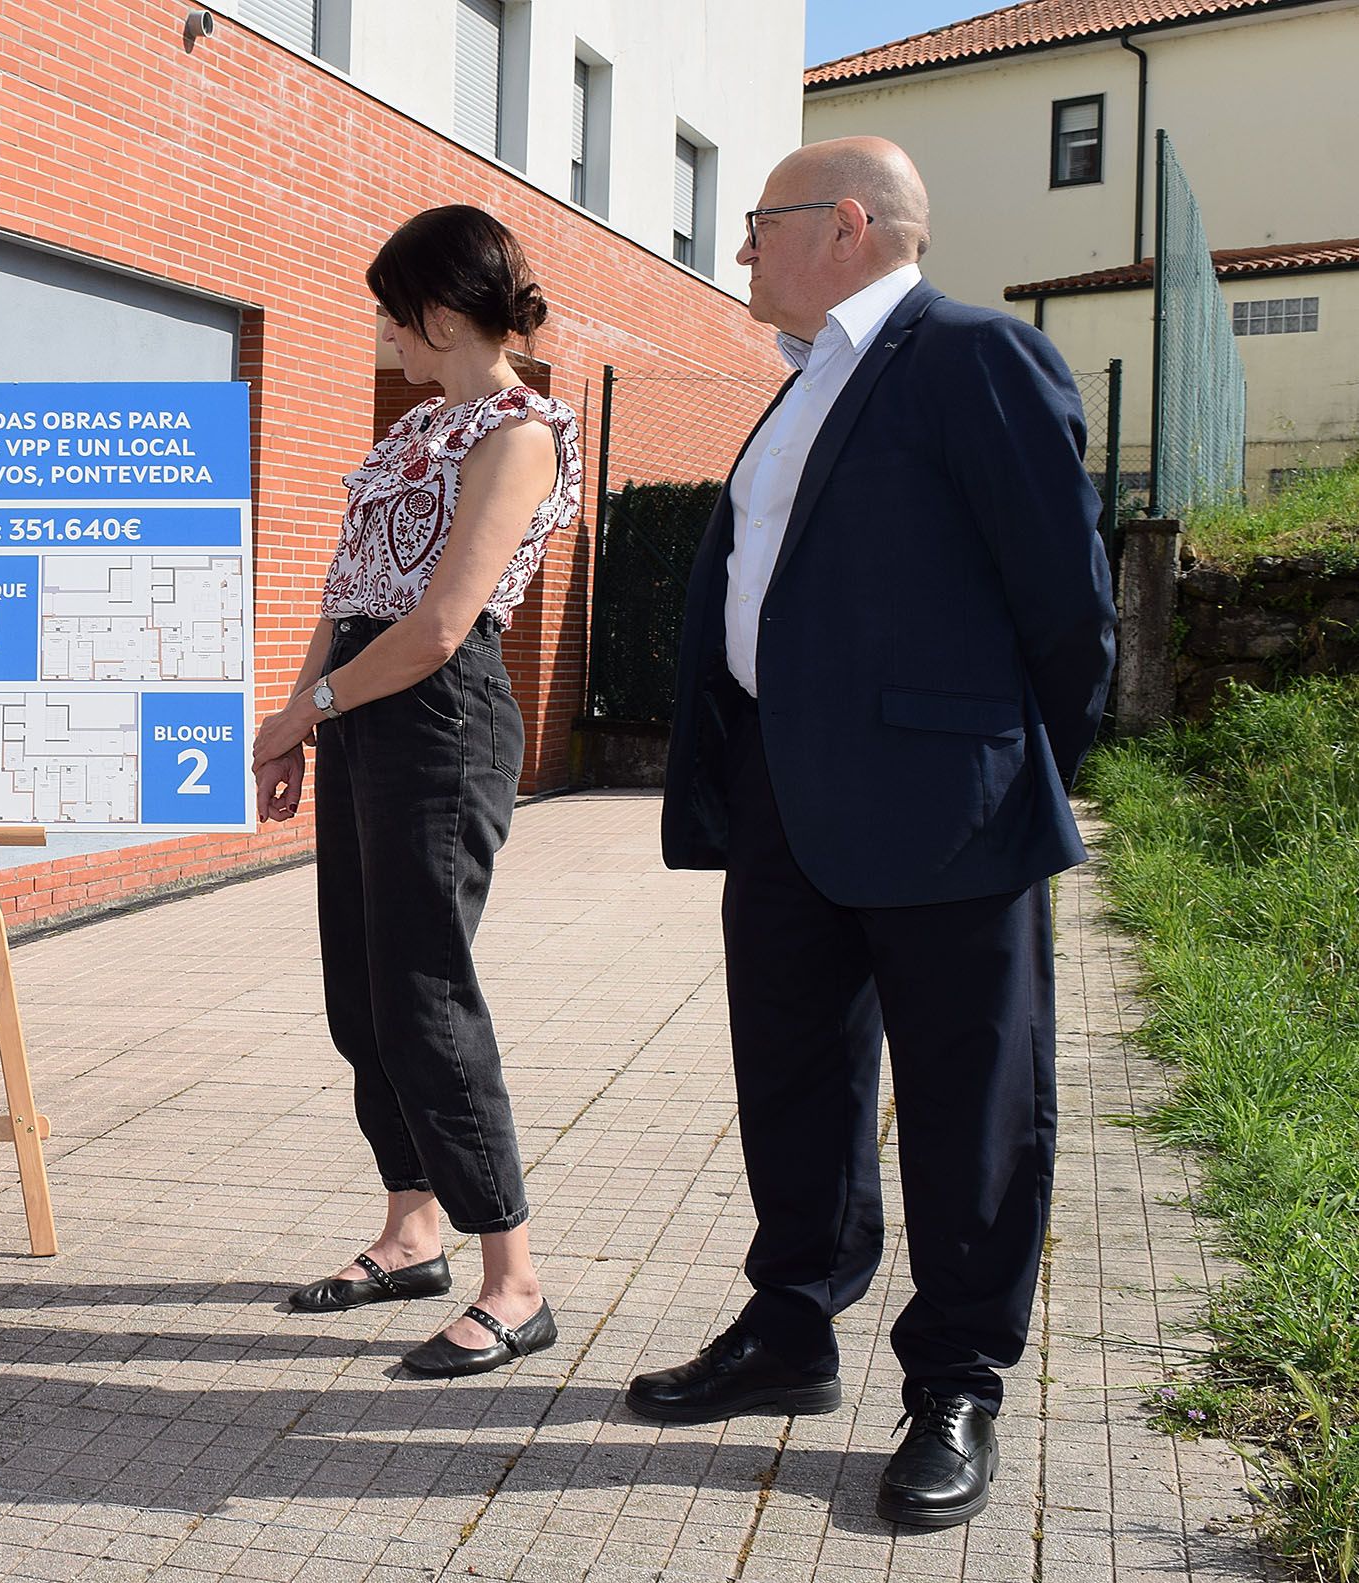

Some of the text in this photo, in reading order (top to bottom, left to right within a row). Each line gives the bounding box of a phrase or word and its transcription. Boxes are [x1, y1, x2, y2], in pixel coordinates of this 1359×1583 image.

[43, 412, 121, 429] OBRAS
[129, 412, 191, 429] PARA
[6, 439, 50, 456] VPP
[58, 439, 70, 456] E
[78, 439, 109, 456] UN
[119, 439, 195, 456] LOCAL
[52, 466, 212, 483] PONTEVEDRA
[10, 519, 140, 540] 351.640€
[155, 726, 232, 743] BLOQUE
[177, 749, 210, 794] 2
